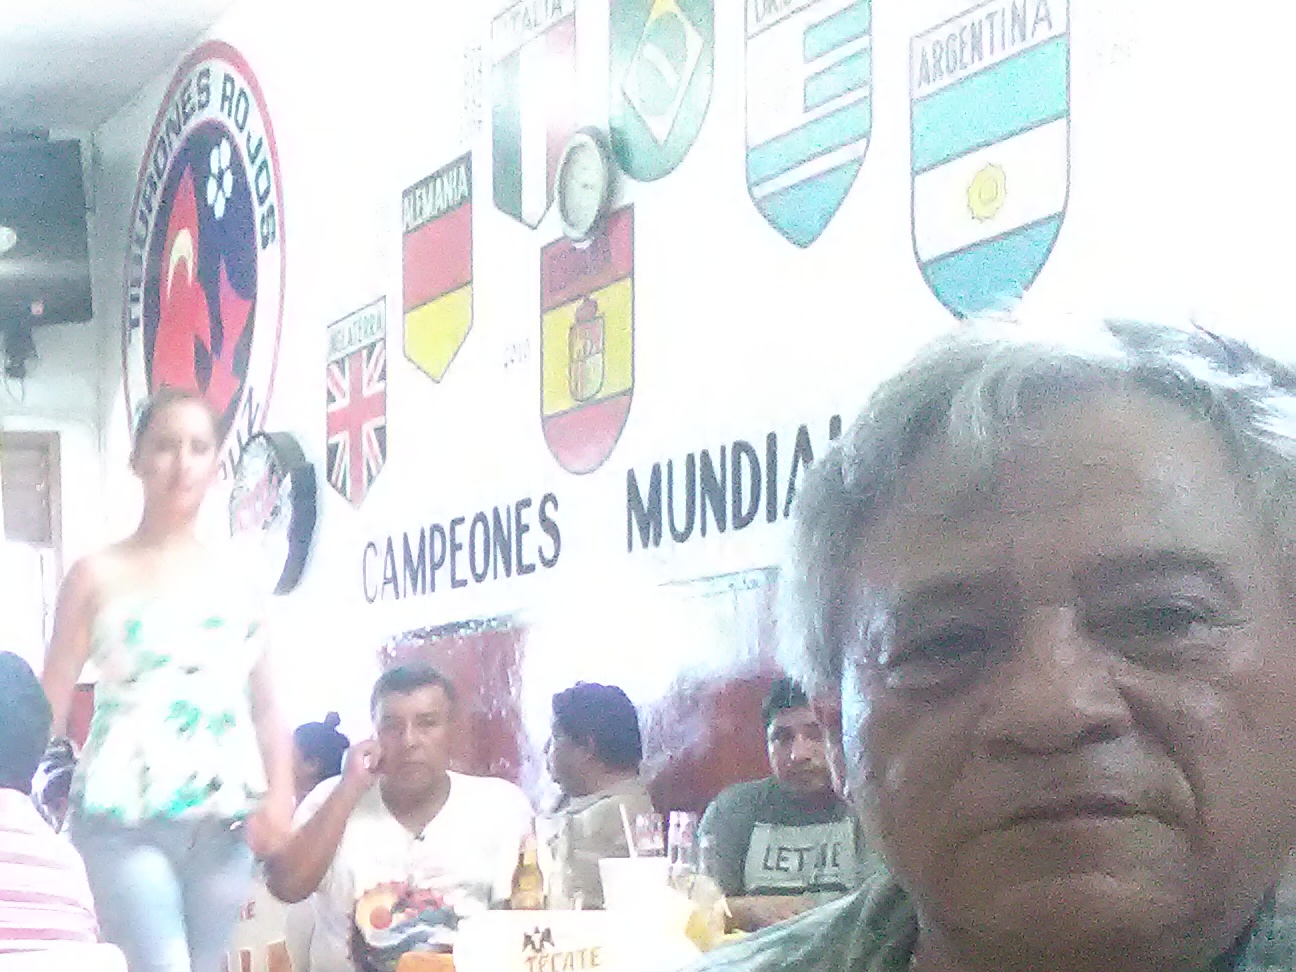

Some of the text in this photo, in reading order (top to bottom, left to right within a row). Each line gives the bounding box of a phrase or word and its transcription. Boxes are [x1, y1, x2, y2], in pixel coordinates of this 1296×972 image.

[917, 0, 1054, 89] ARGENTINA
[127, 67, 211, 345] TIBURONES
[220, 72, 276, 250] ROJOS
[362, 414, 842, 604] CAMPEONES MUNDIA
